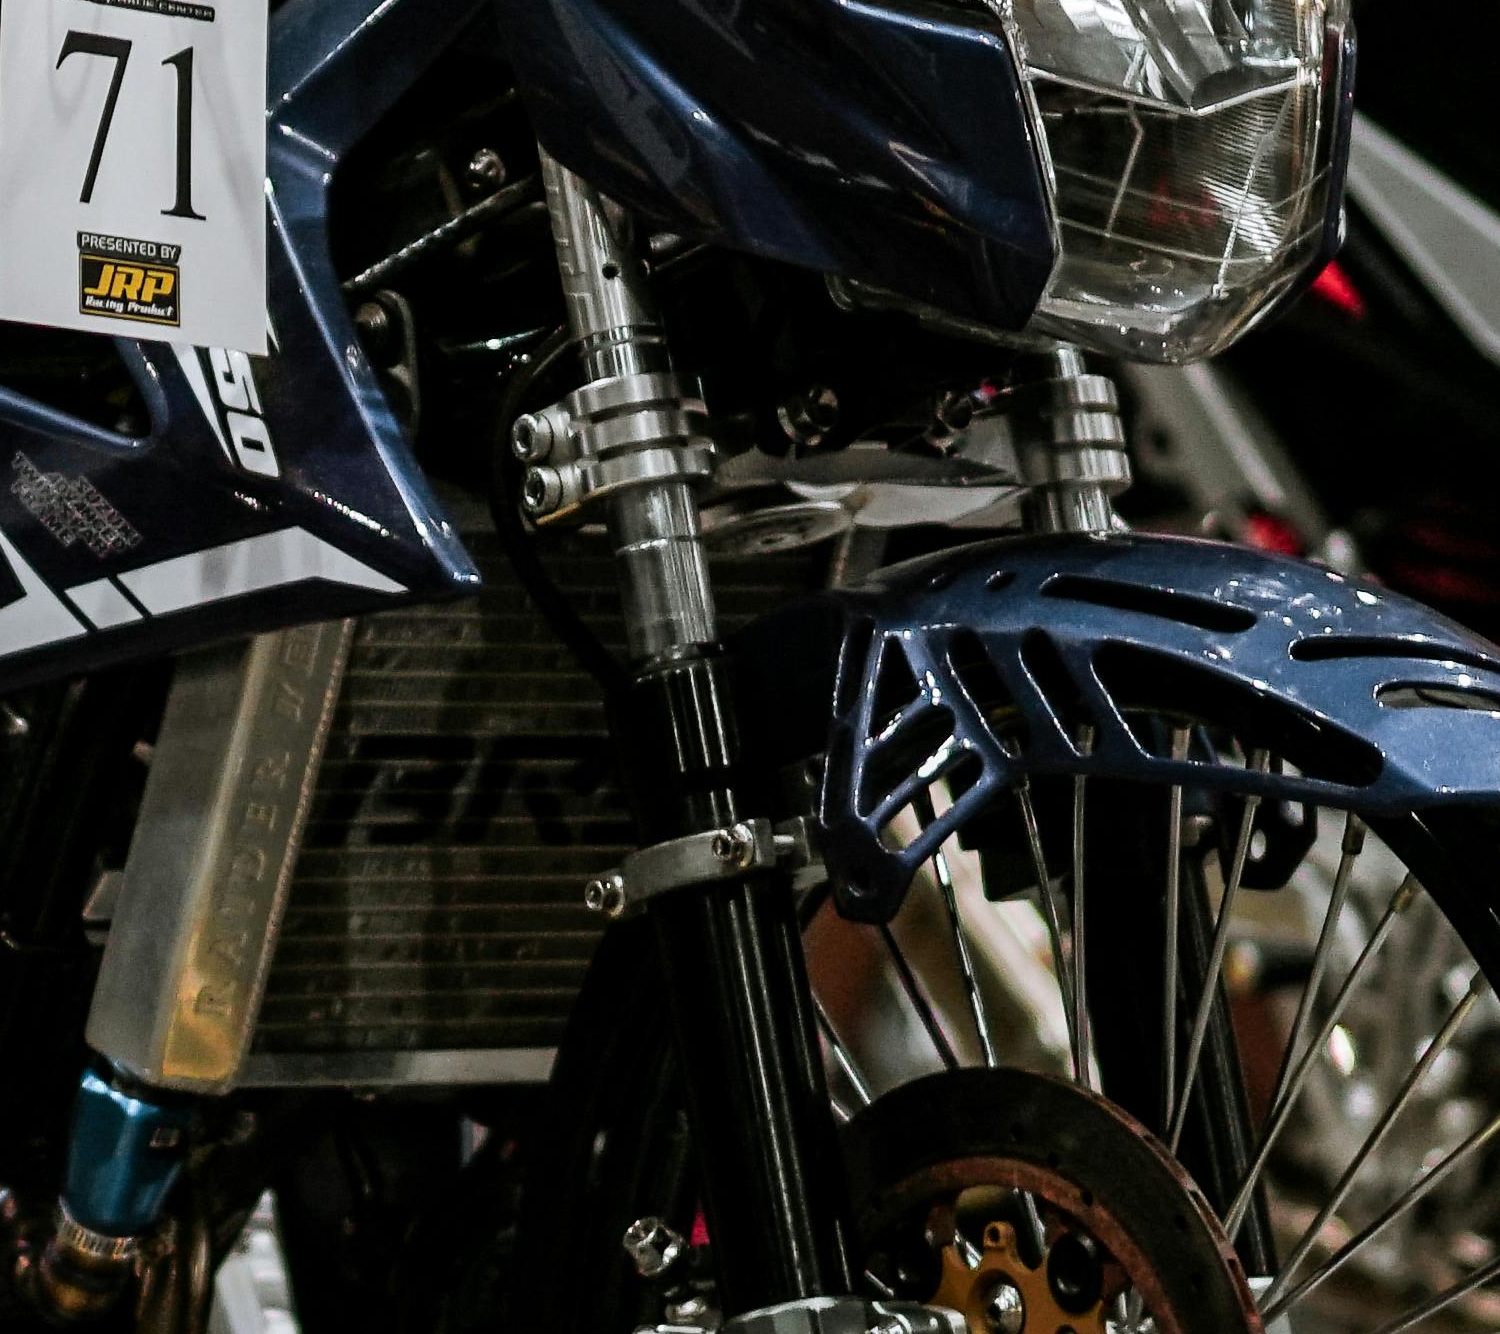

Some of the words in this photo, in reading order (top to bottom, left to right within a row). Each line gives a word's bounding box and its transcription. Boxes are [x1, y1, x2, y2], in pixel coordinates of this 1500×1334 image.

[56, 30, 206, 221] 71
[81, 233, 156, 257] PRESENTED
[160, 245, 177, 260] BY
[84, 263, 175, 303] JRP
[85, 295, 124, 314] Racing
[127, 301, 174, 317] Product
